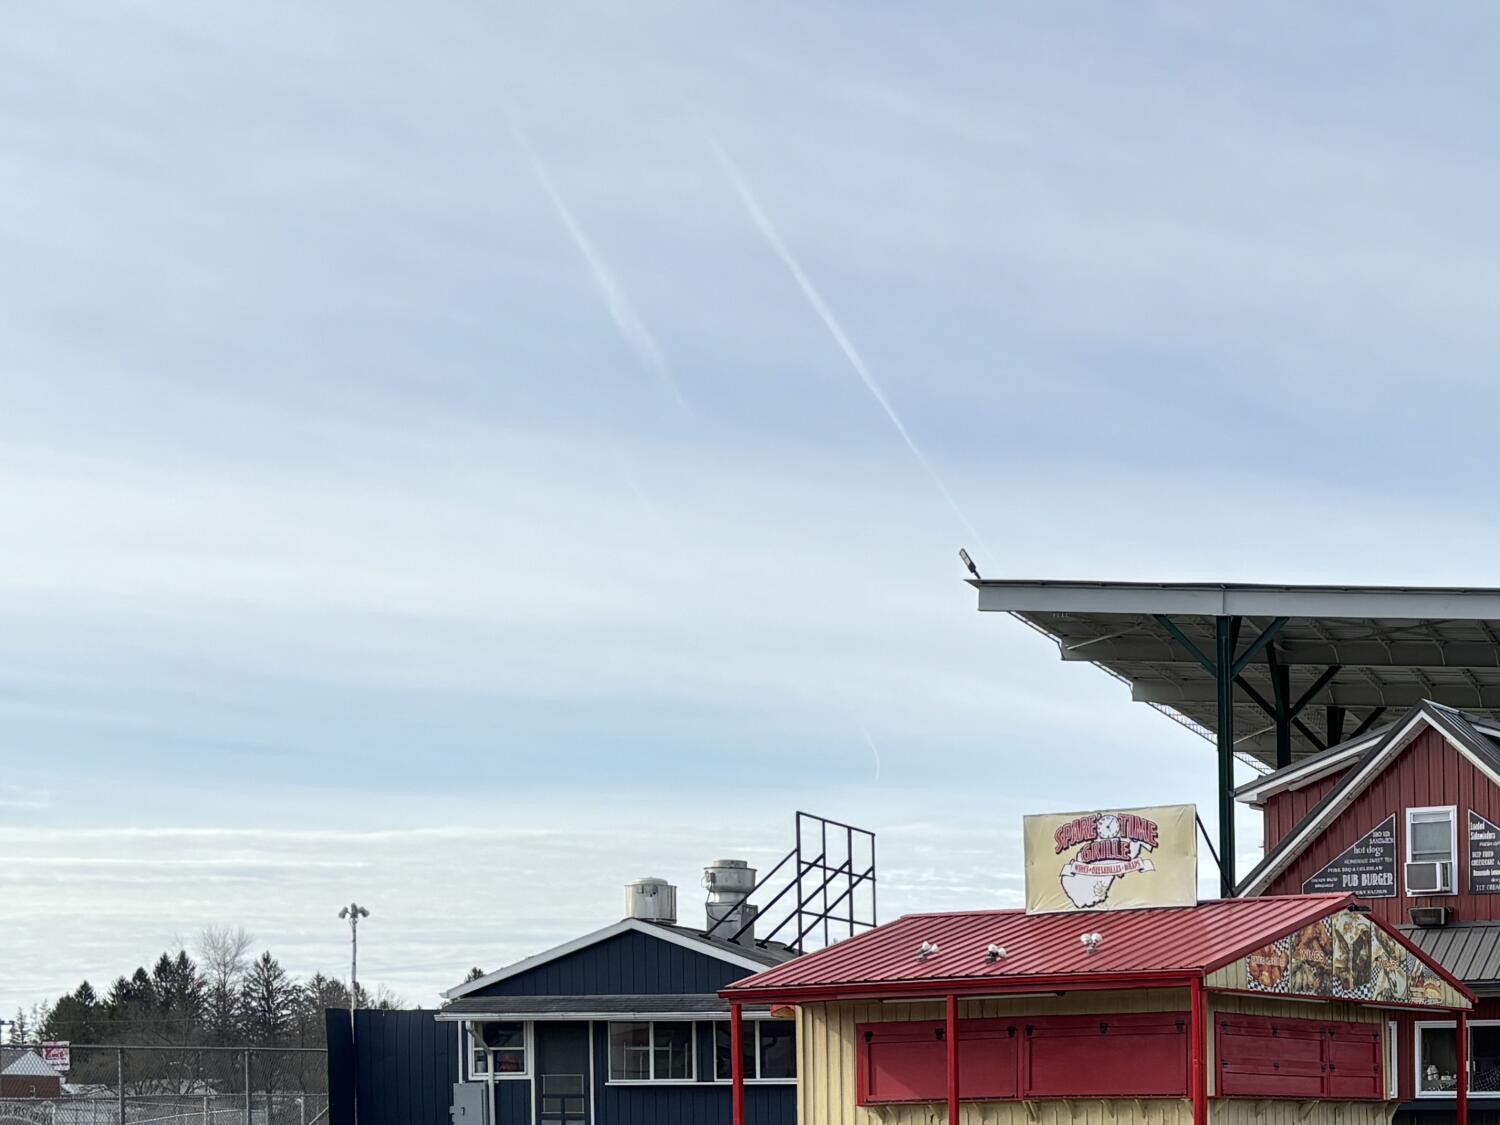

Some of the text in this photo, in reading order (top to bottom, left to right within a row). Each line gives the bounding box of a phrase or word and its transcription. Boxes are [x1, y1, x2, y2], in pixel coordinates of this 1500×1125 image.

[1054, 813, 1159, 854] SPARE TIME
[1080, 840, 1131, 863] GRILLE
[1353, 845, 1384, 857] hot dogs
[1342, 872, 1393, 888] PUB BURGER
[1301, 949, 1325, 961] WINGS
